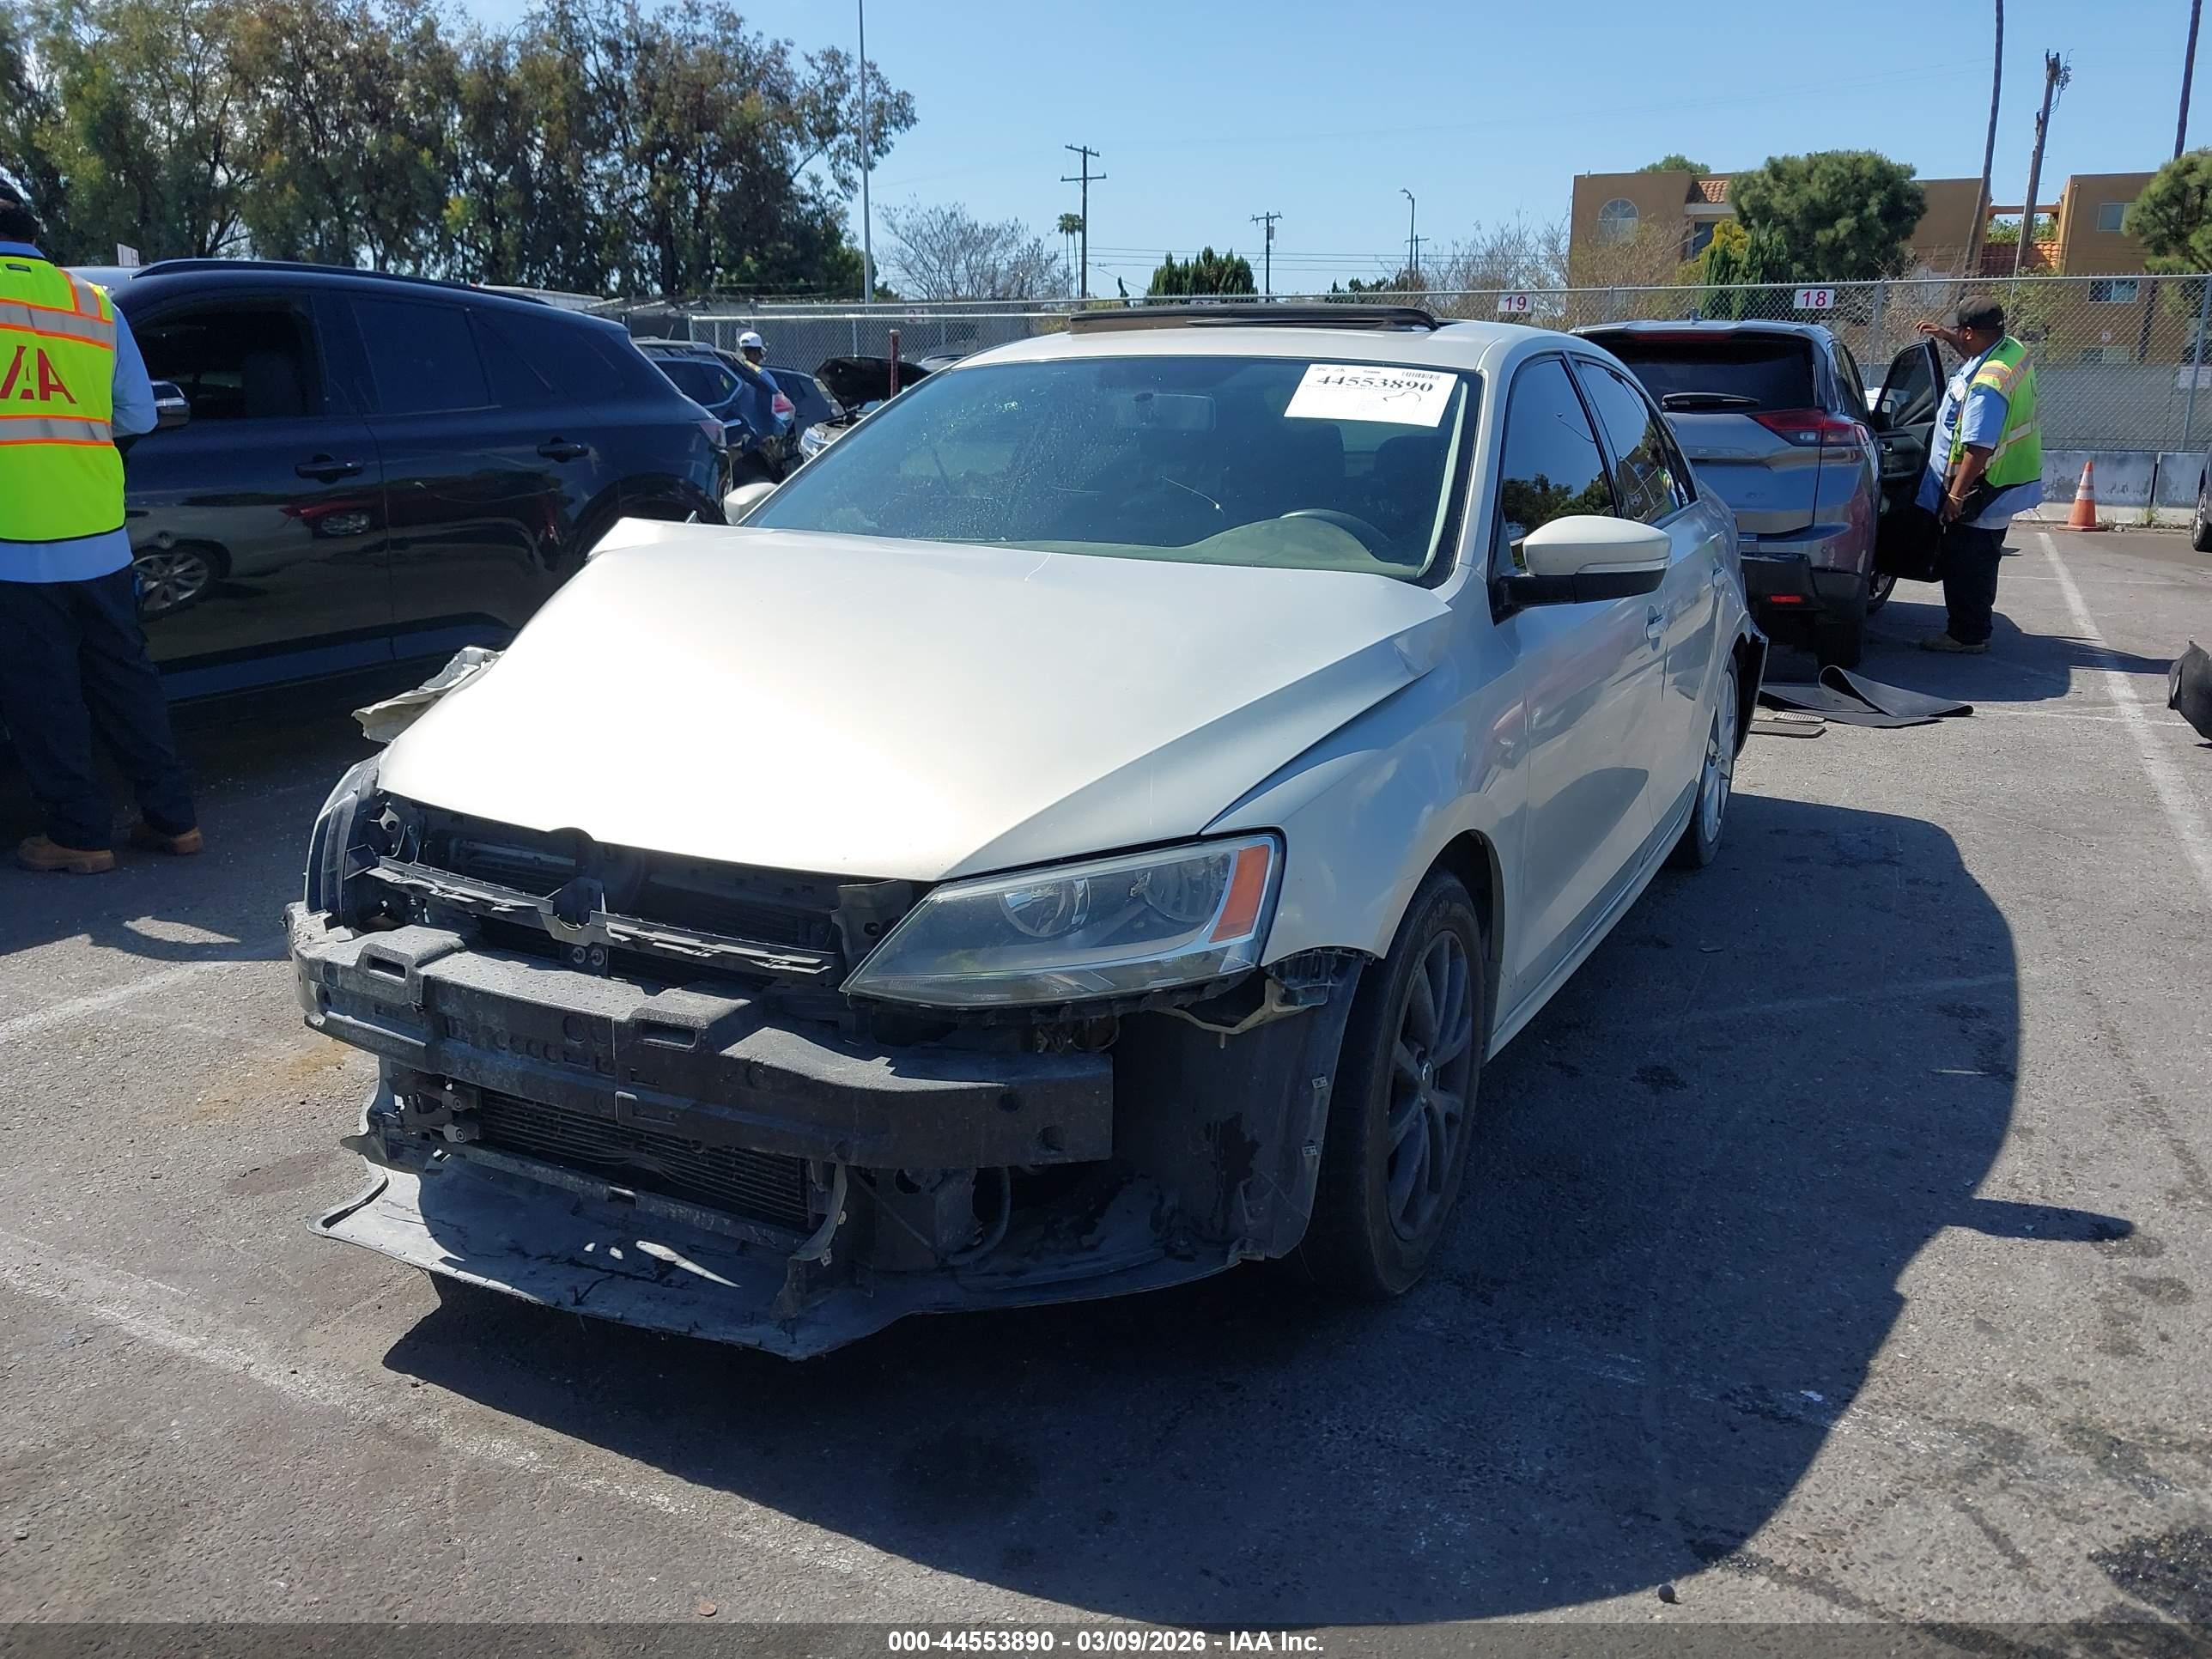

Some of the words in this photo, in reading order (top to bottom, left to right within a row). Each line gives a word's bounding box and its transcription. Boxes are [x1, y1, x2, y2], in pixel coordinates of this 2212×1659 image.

[1504, 295, 1527, 311] 19
[1802, 290, 1826, 307] 18
[1316, 375, 1433, 392] 44553890
